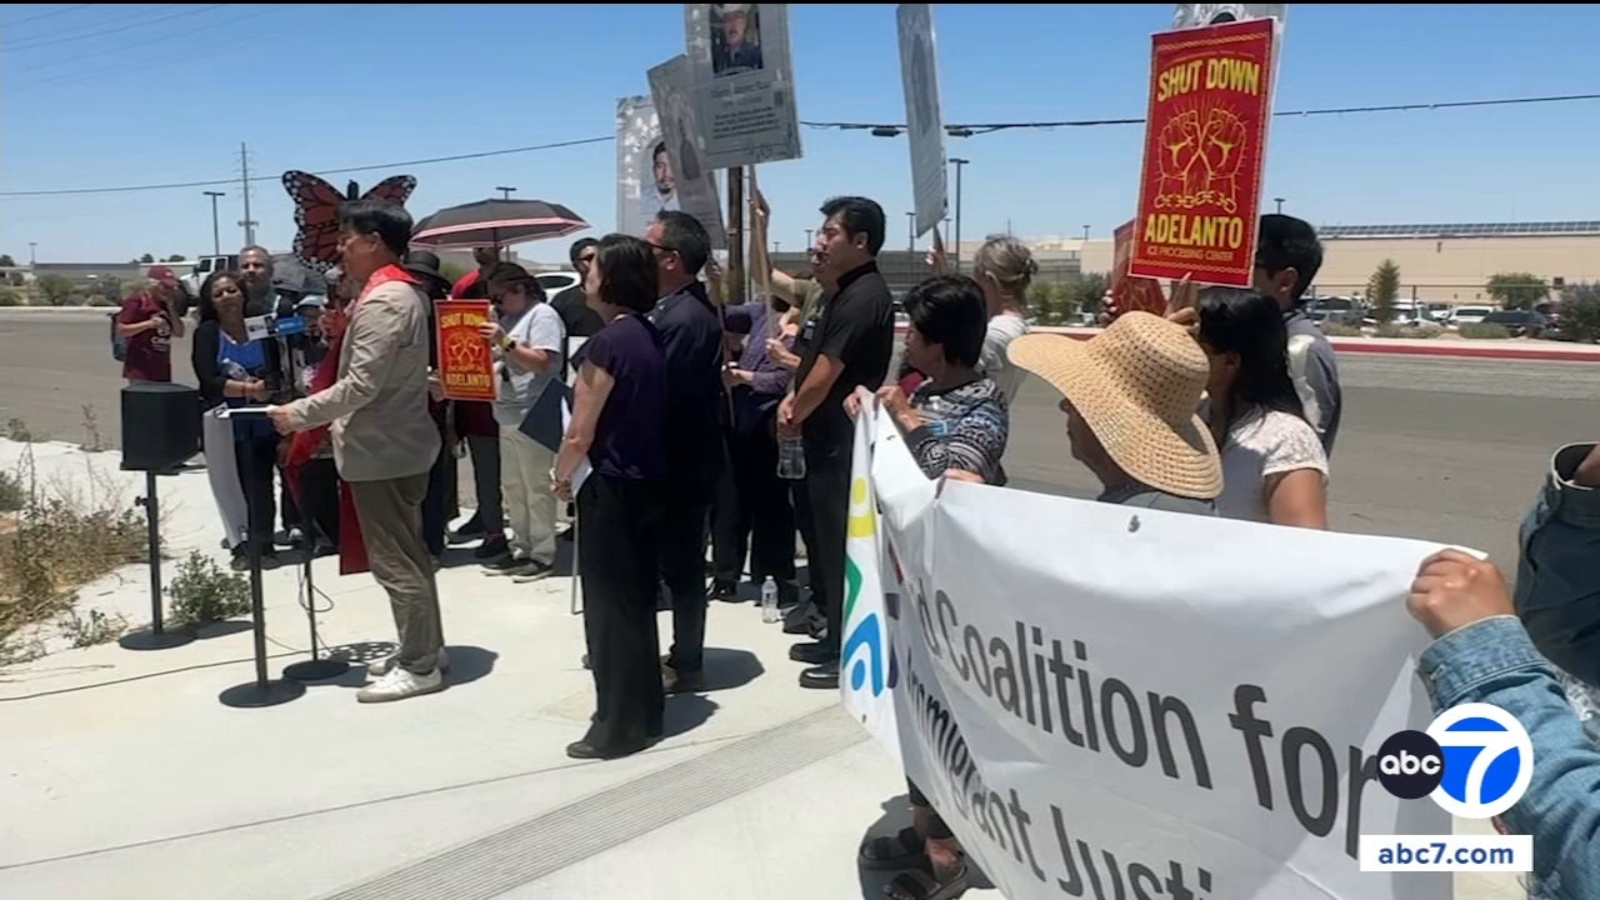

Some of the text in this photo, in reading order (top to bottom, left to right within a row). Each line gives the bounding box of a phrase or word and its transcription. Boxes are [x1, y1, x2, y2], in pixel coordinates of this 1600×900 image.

[1157, 60, 1203, 102] SHUT
[1206, 58, 1260, 96] DOWN
[1144, 213, 1243, 249] ADELANTO
[935, 589, 1213, 790] Coalition
[1227, 684, 1378, 861] for
[1050, 804, 1212, 900] Just
